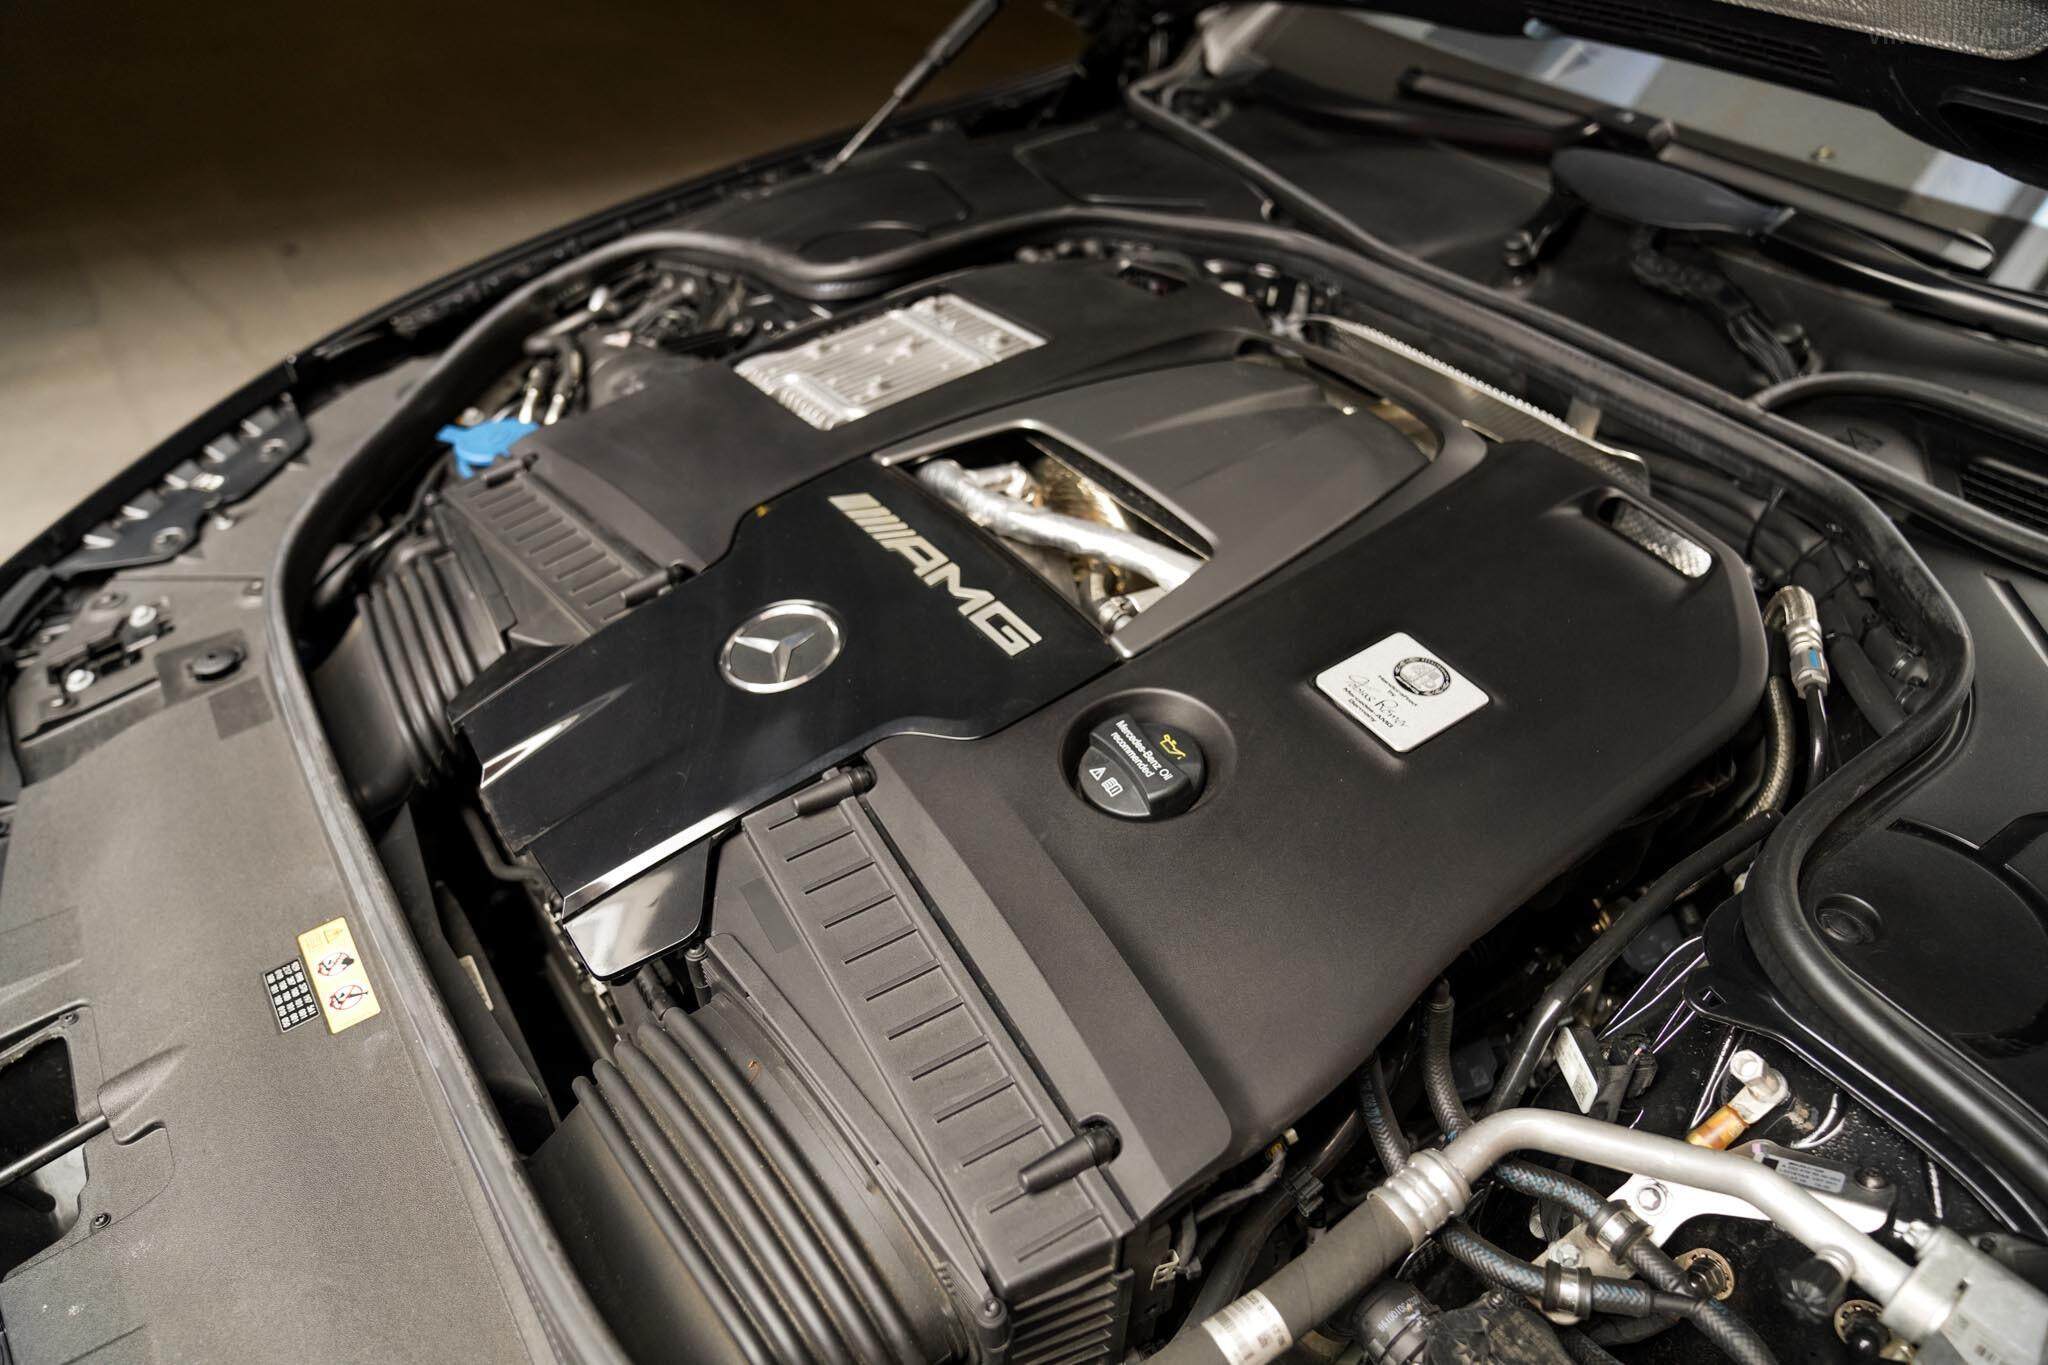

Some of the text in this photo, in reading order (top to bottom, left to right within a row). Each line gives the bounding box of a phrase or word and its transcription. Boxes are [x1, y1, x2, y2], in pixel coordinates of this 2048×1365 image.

[880, 534, 1043, 657] AMG
[1111, 732, 1155, 778] recommended
[1116, 720, 1173, 781] Mercedes-Benz Oil
